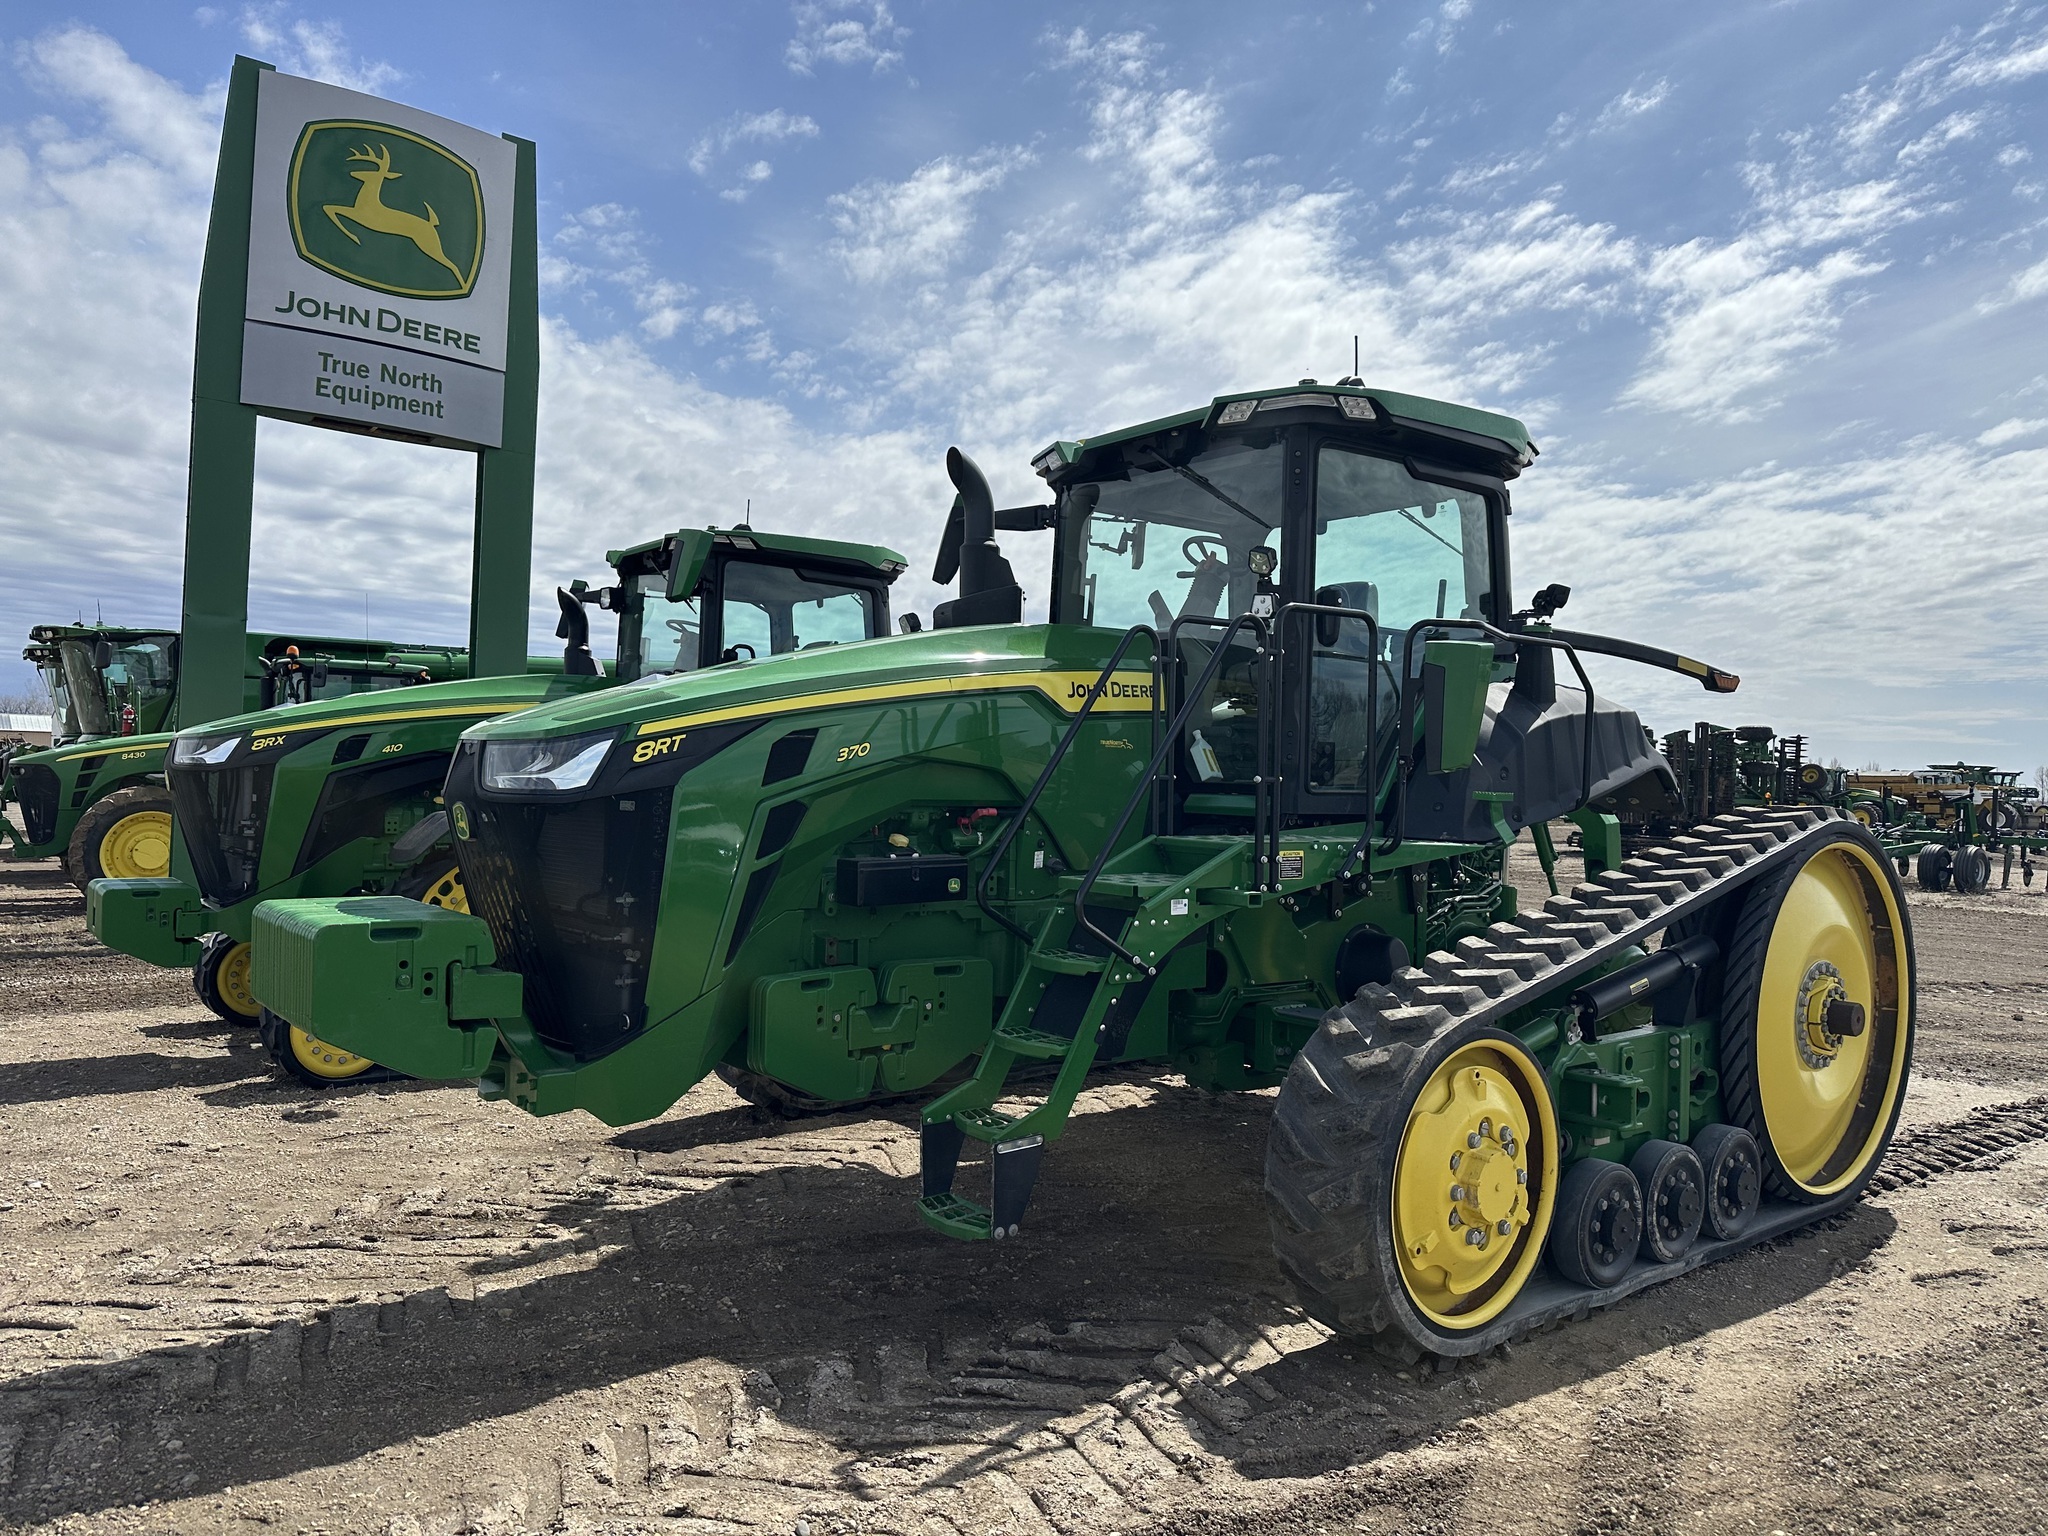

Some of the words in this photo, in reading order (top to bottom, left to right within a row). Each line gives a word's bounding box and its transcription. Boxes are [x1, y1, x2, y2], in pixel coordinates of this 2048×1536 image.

[275, 291, 370, 328] JOHN
[377, 308, 481, 354] DEERE
[317, 351, 371, 379] True
[380, 361, 443, 394] North
[315, 376, 445, 419] Equipment
[121, 751, 147, 760] 8430
[251, 735, 287, 751] 8RX
[381, 743, 404, 754] 410
[632, 734, 687, 763] 8RT
[836, 742, 871, 763] 370
